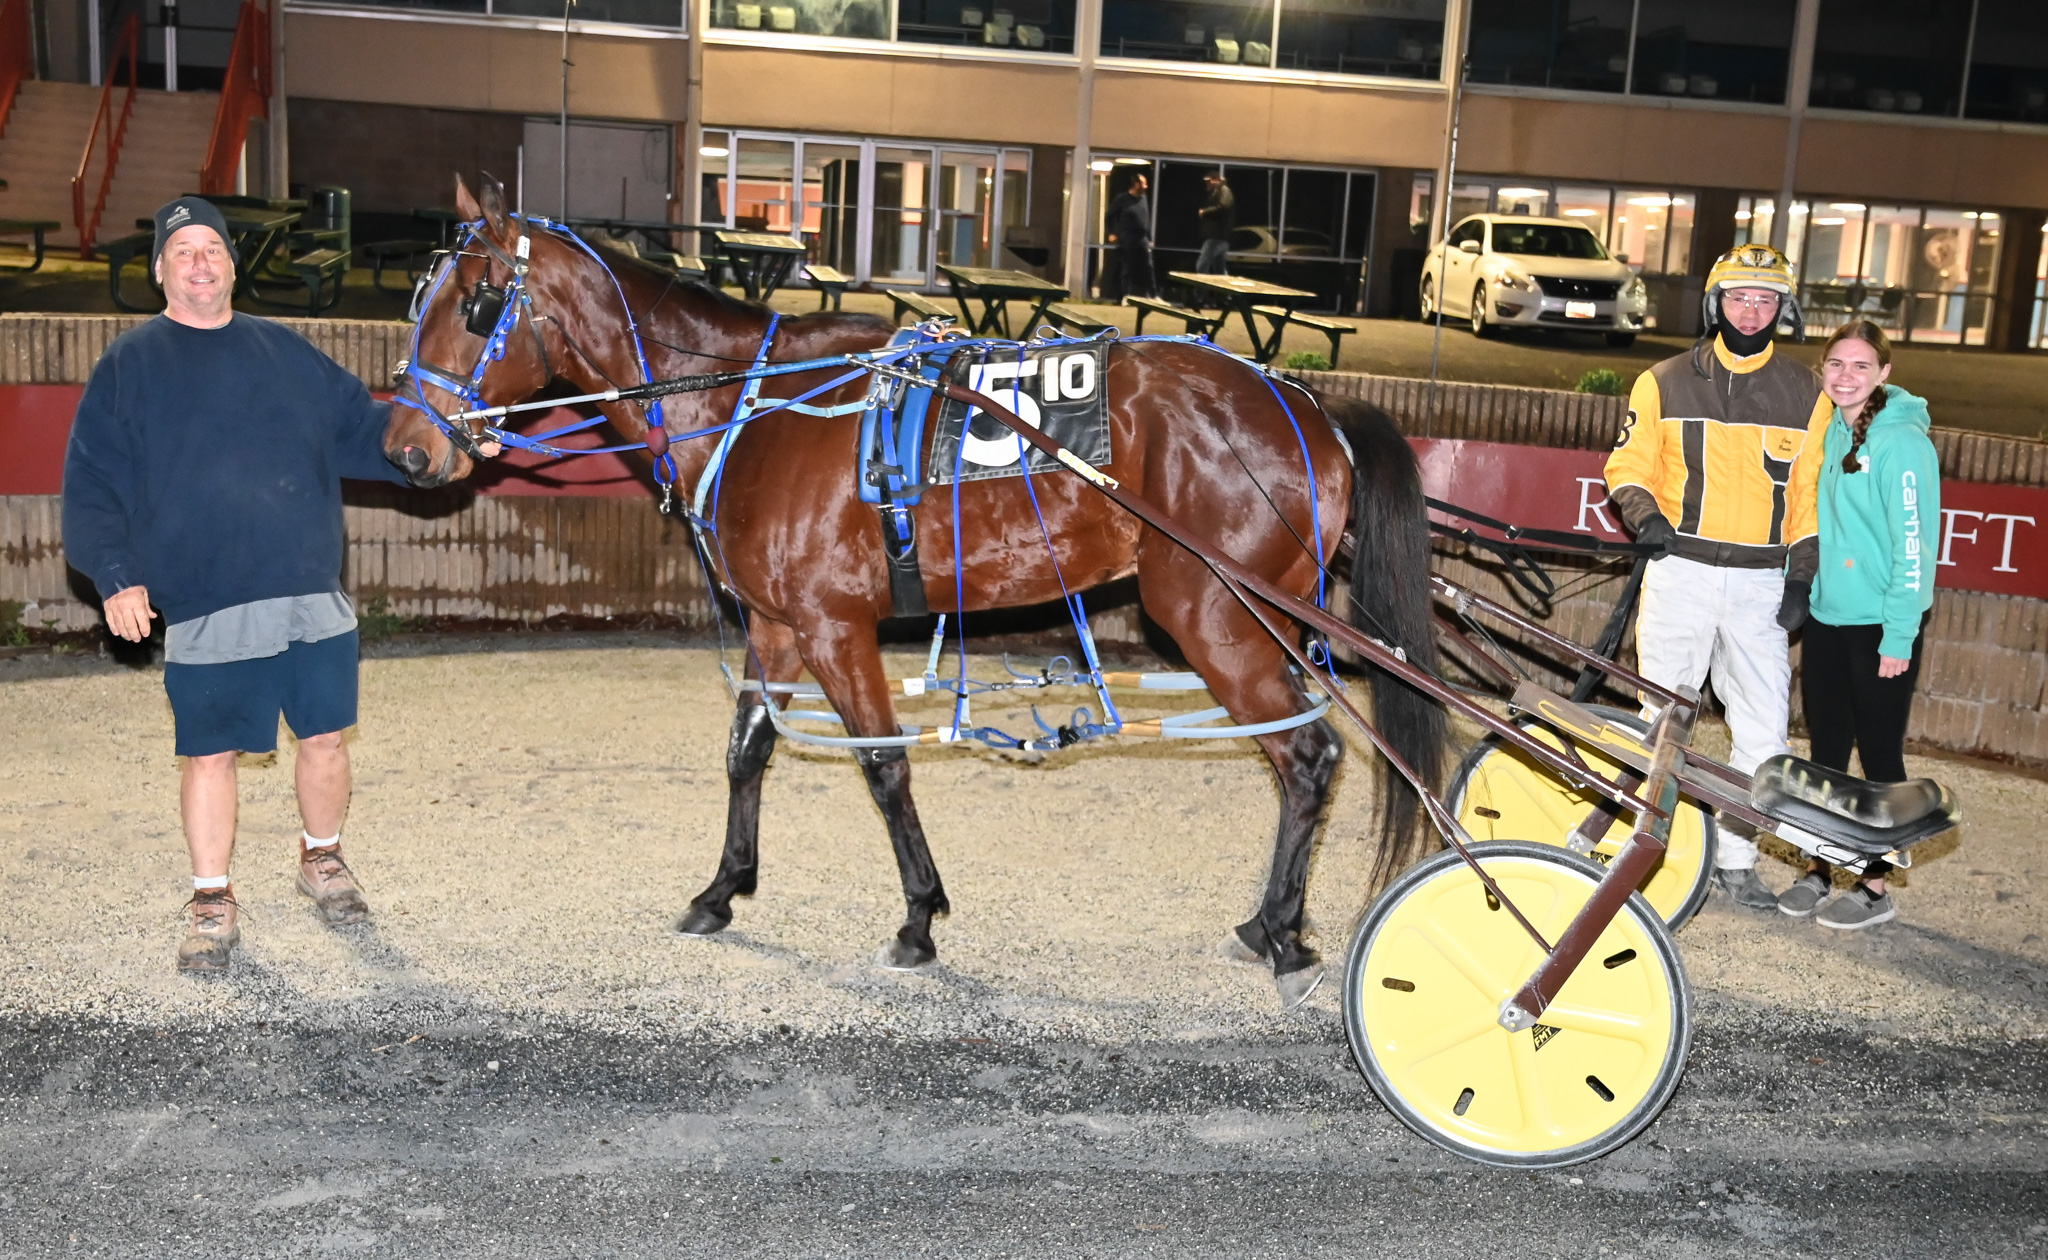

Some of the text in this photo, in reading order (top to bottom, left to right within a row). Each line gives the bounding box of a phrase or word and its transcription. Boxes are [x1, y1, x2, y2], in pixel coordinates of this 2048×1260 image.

[961, 353, 1096, 467] 5 10
[1902, 470, 1922, 592] carhartt
[1534, 1026, 1552, 1048] FMT
